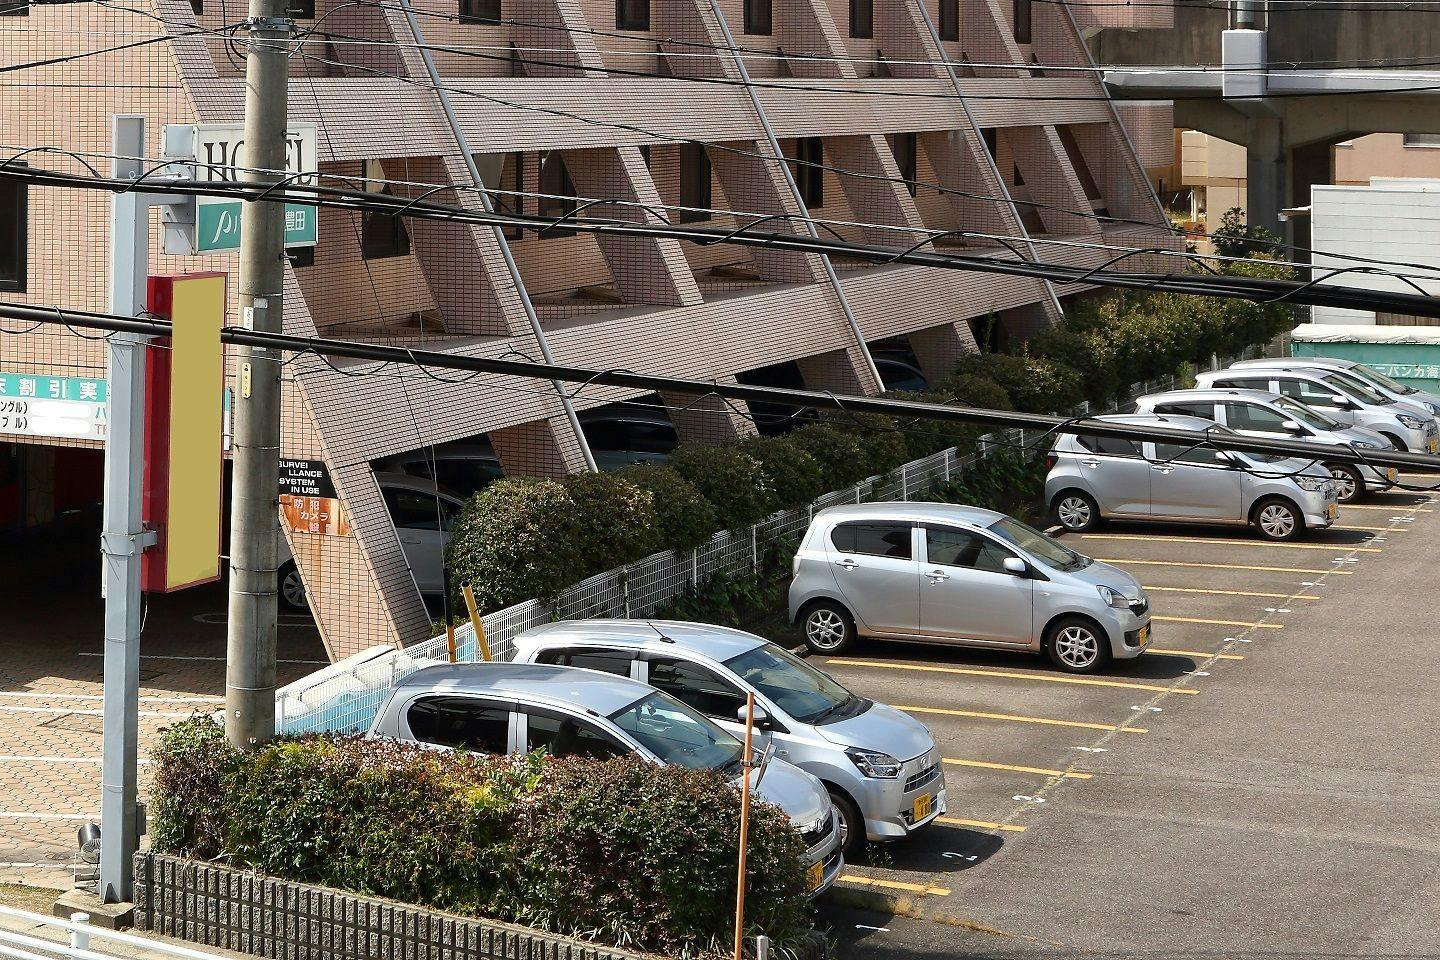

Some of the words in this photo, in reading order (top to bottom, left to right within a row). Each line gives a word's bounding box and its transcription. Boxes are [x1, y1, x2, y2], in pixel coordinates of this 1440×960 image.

[288, 469, 323, 478] LLANCE
[279, 478, 315, 486] SYSTEM
[301, 487, 320, 495] USE
